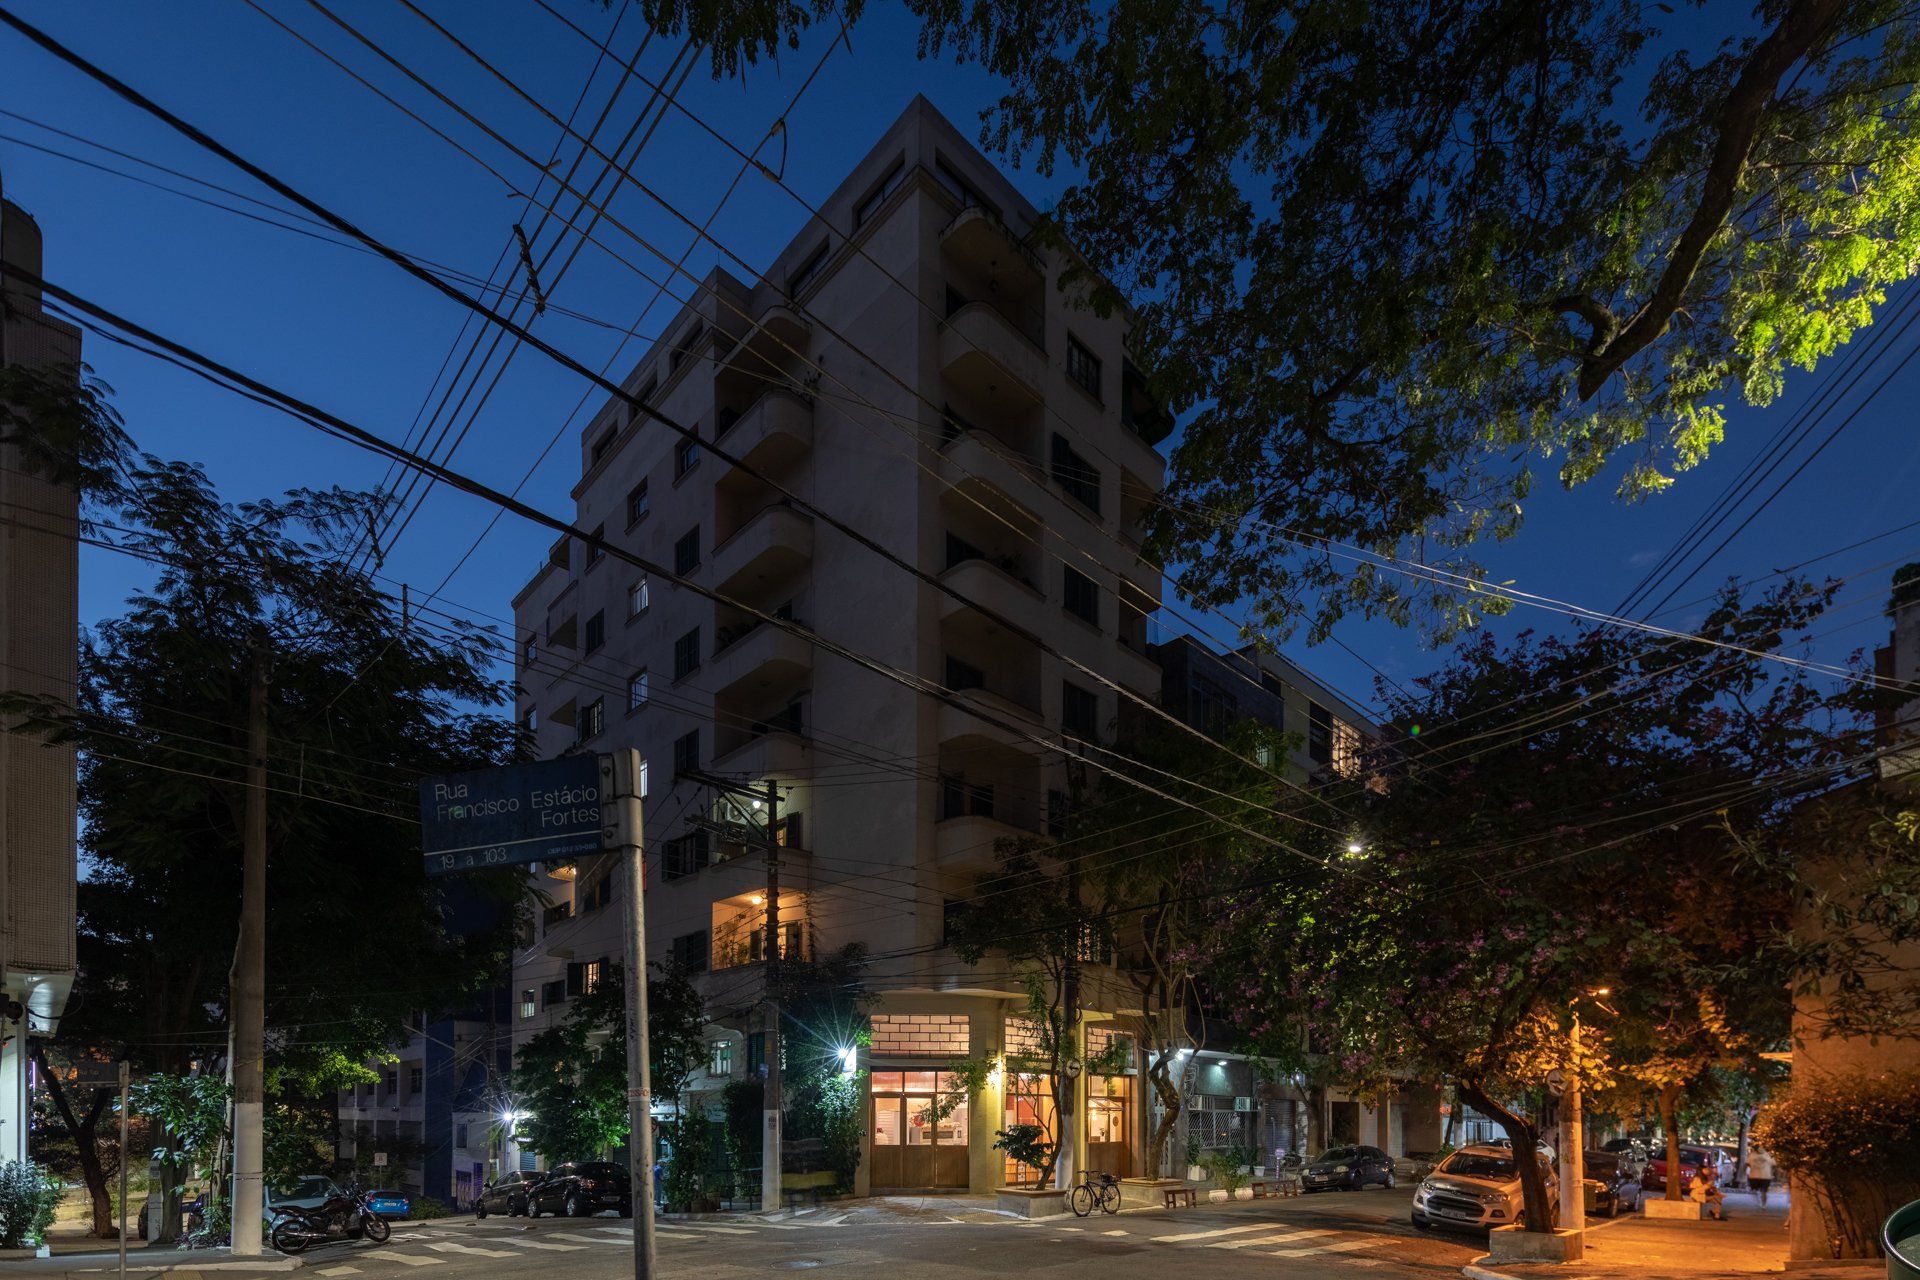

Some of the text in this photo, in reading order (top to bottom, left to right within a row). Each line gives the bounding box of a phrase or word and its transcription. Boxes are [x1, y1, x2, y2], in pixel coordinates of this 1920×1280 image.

[435, 783, 468, 801] Rua
[437, 785, 598, 823] Francisco Estácio
[541, 807, 599, 828] Fortes
[439, 848, 507, 870] 19 a 103
